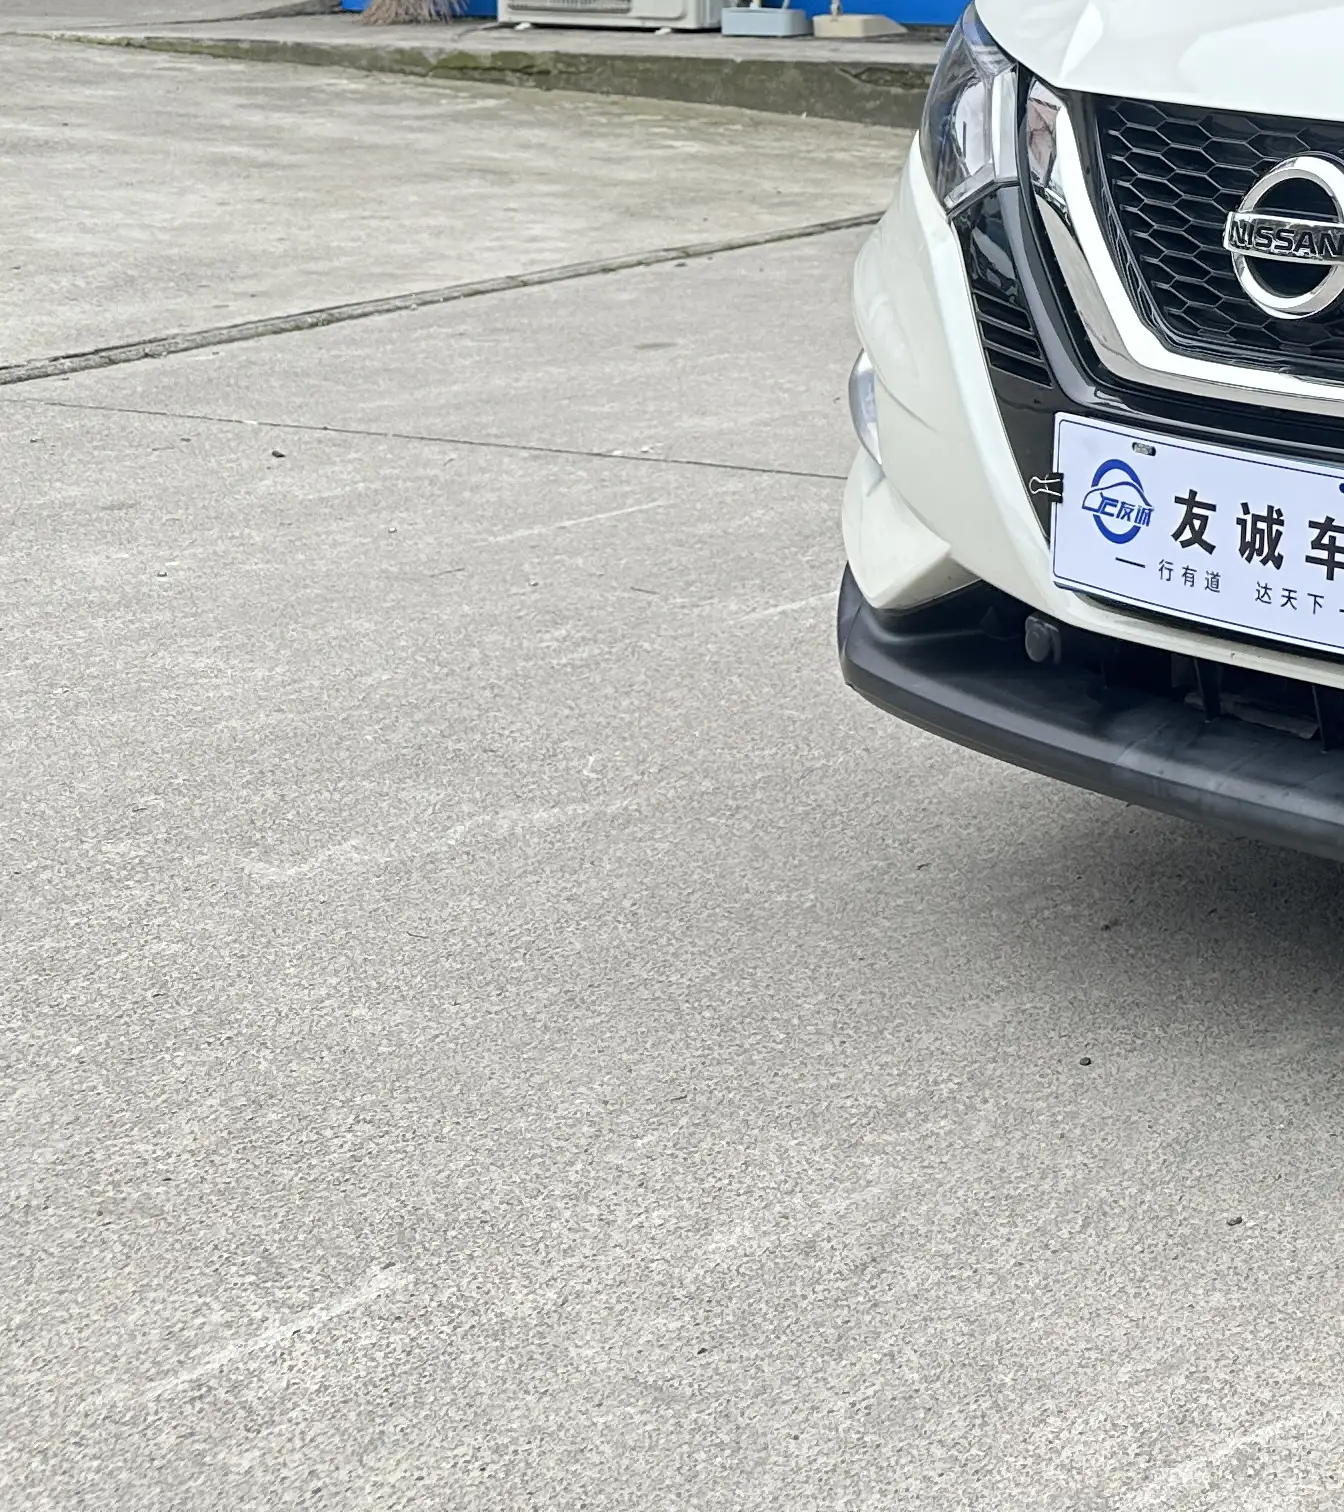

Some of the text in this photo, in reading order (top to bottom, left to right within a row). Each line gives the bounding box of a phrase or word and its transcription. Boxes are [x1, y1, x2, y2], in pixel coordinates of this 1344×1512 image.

[1158, 558, 1325, 615] 行有道 达天下
